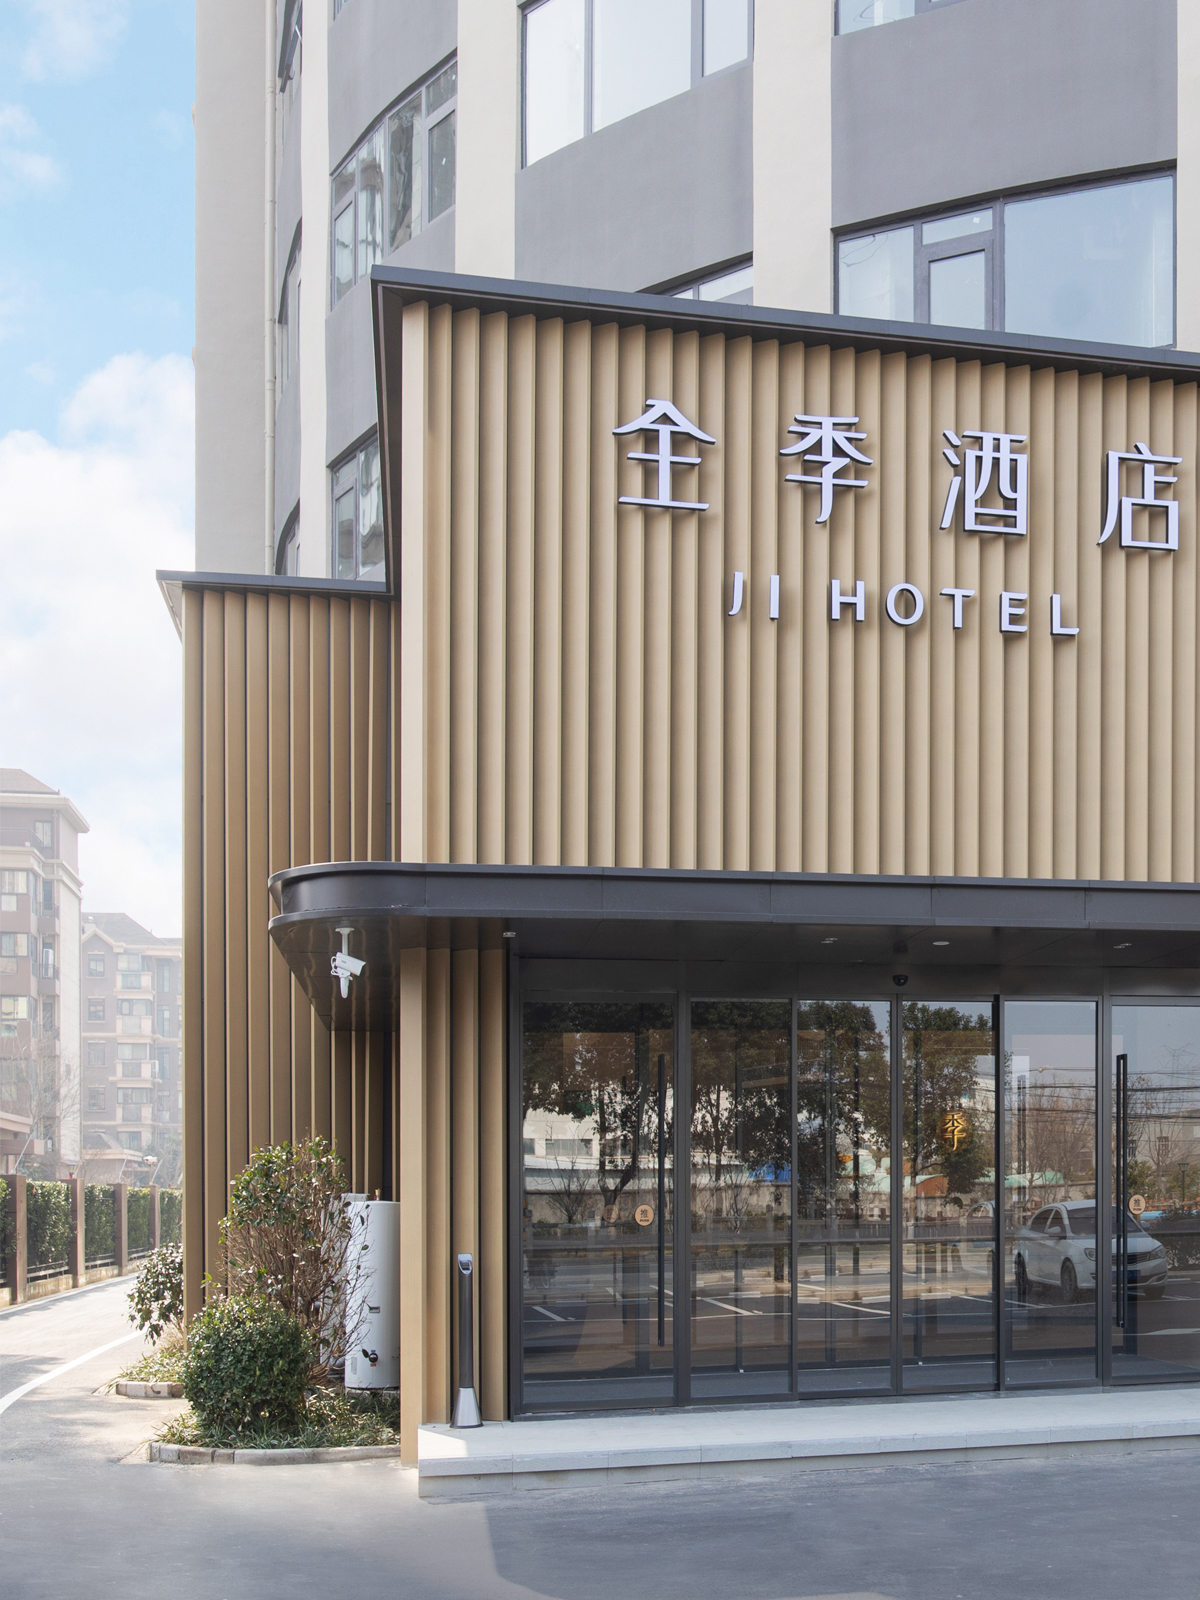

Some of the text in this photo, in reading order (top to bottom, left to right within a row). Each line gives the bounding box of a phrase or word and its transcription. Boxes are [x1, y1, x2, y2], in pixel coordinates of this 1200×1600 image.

[612, 398, 1183, 551] 全季酒店
[728, 571, 1080, 636] JI HOTEL
